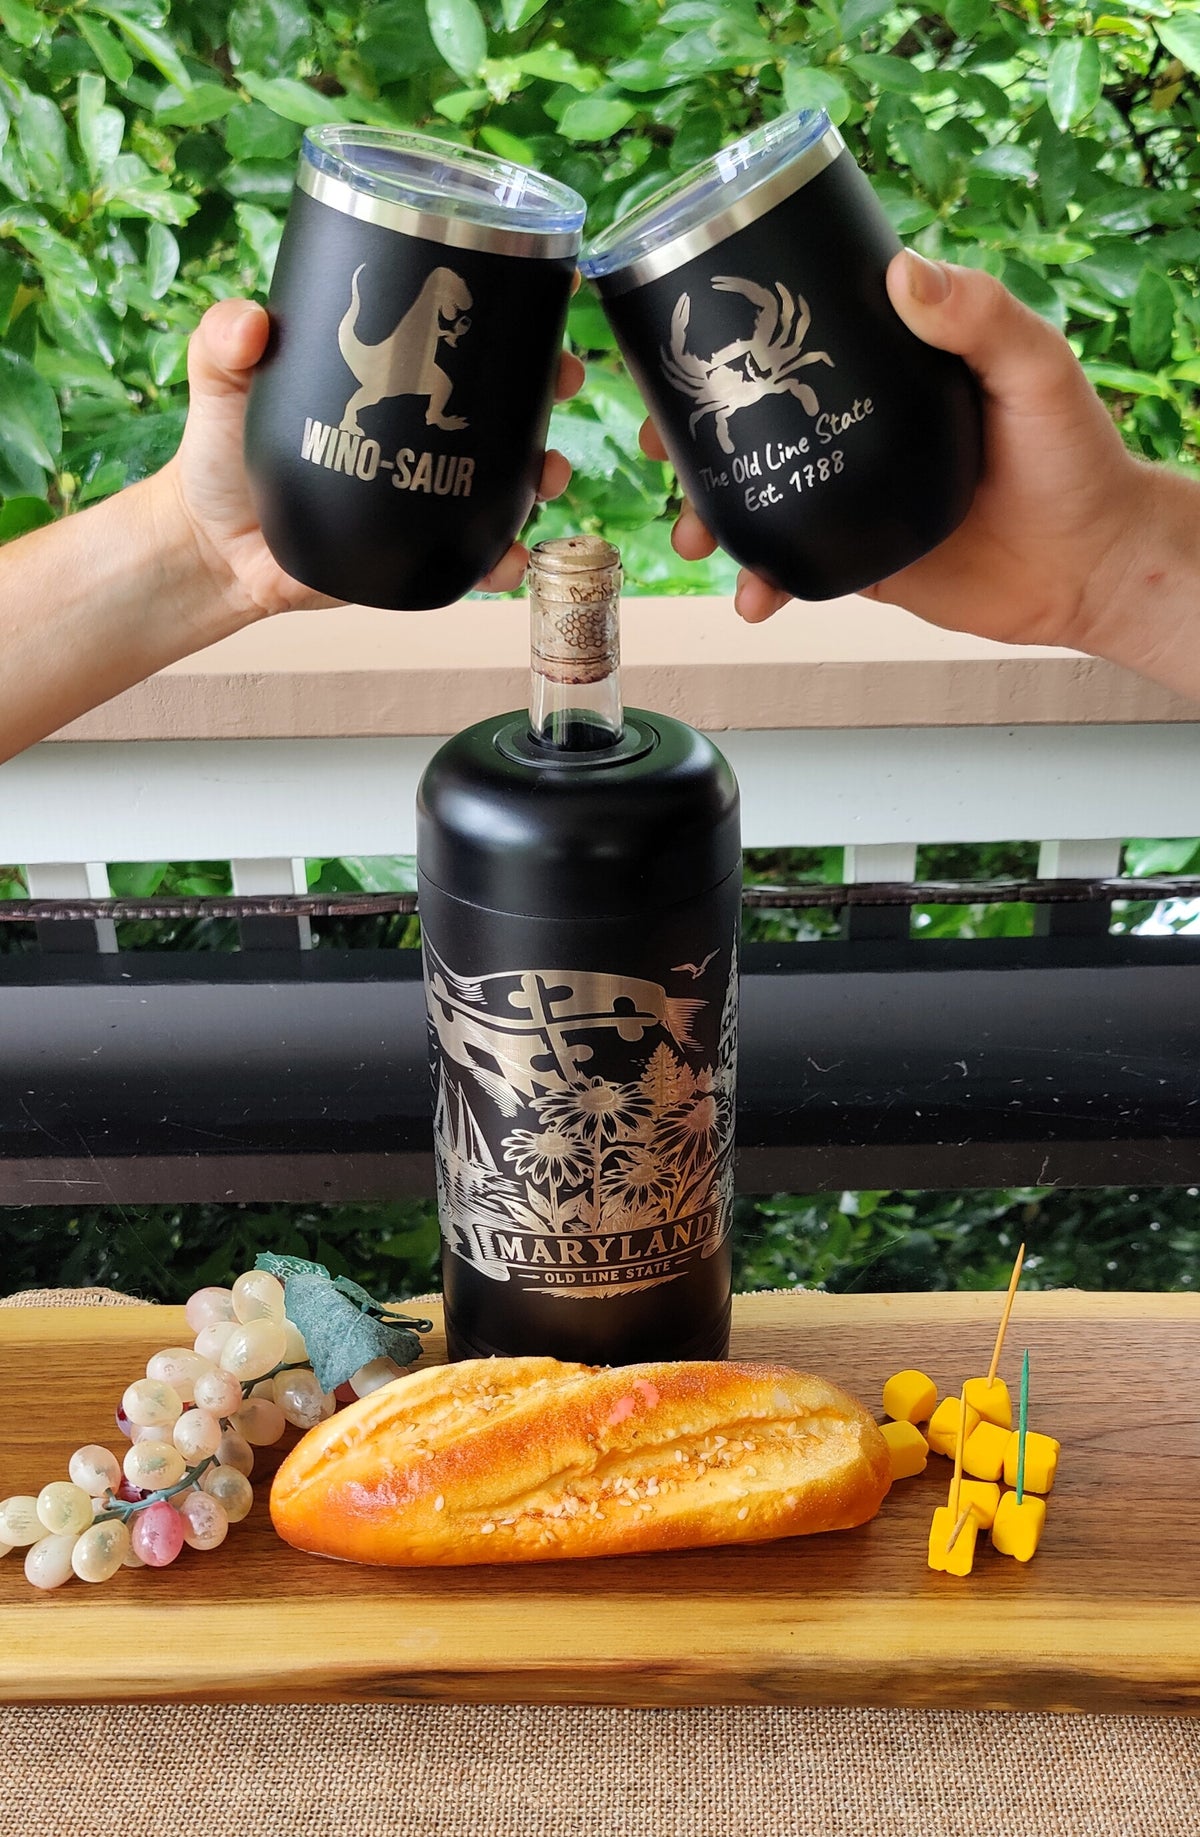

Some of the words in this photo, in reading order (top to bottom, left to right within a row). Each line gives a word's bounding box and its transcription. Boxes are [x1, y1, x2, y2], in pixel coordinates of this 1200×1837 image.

[301, 417, 475, 497] WINO-SAUR
[701, 467, 730, 492] The
[732, 451, 762, 484] Old
[765, 437, 810, 471] Line
[815, 398, 874, 445] State
[745, 483, 784, 512] Est.
[789, 450, 845, 493] 1788
[495, 1213, 713, 1265] MARYLAND
[544, 1271, 576, 1284] OLD
[582, 1269, 620, 1283] LINE
[626, 1261, 671, 1279] STATE
